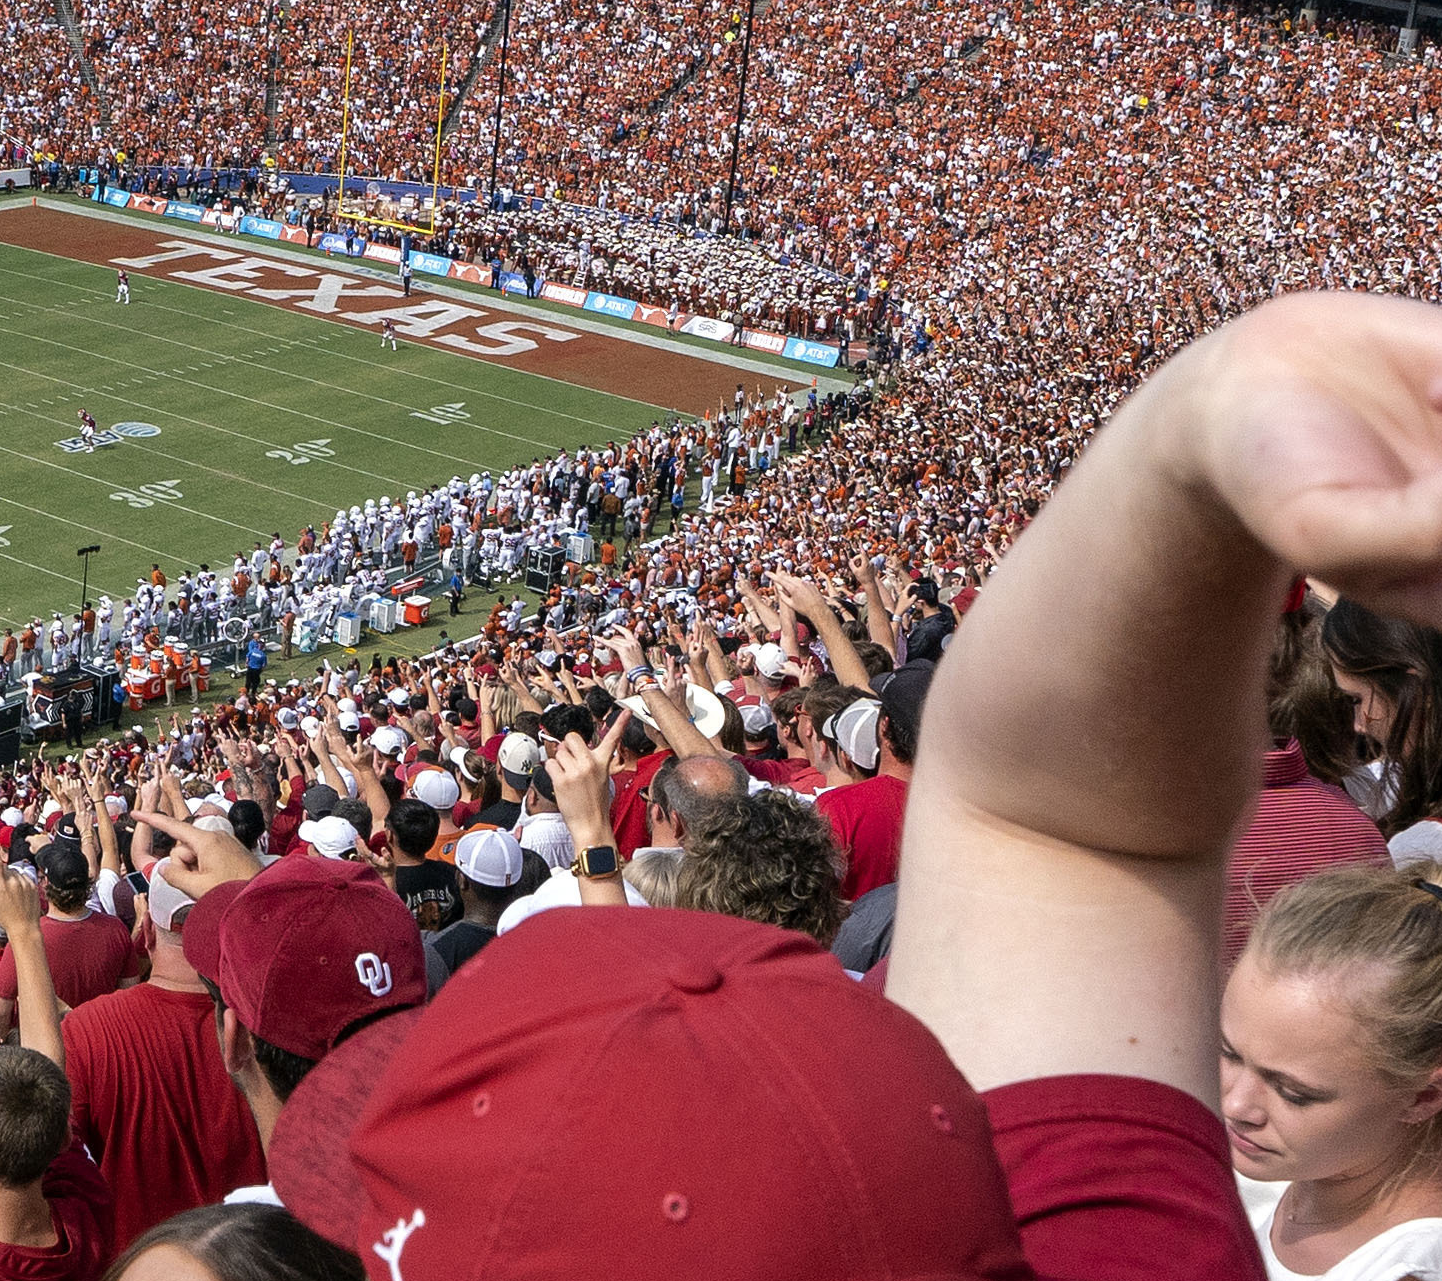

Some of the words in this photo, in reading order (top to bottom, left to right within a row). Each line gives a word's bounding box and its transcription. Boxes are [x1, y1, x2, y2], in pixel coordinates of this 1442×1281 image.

[257, 222, 274, 233] AT&T
[425, 259, 444, 270] AT&T
[109, 239, 582, 356] TEXAS
[605, 300, 628, 312] AT&T
[805, 347, 829, 360] AT&T
[410, 405, 471, 425] 10
[265, 441, 335, 465] 20
[109, 482, 184, 509] 30
[354, 952, 393, 997] OU
